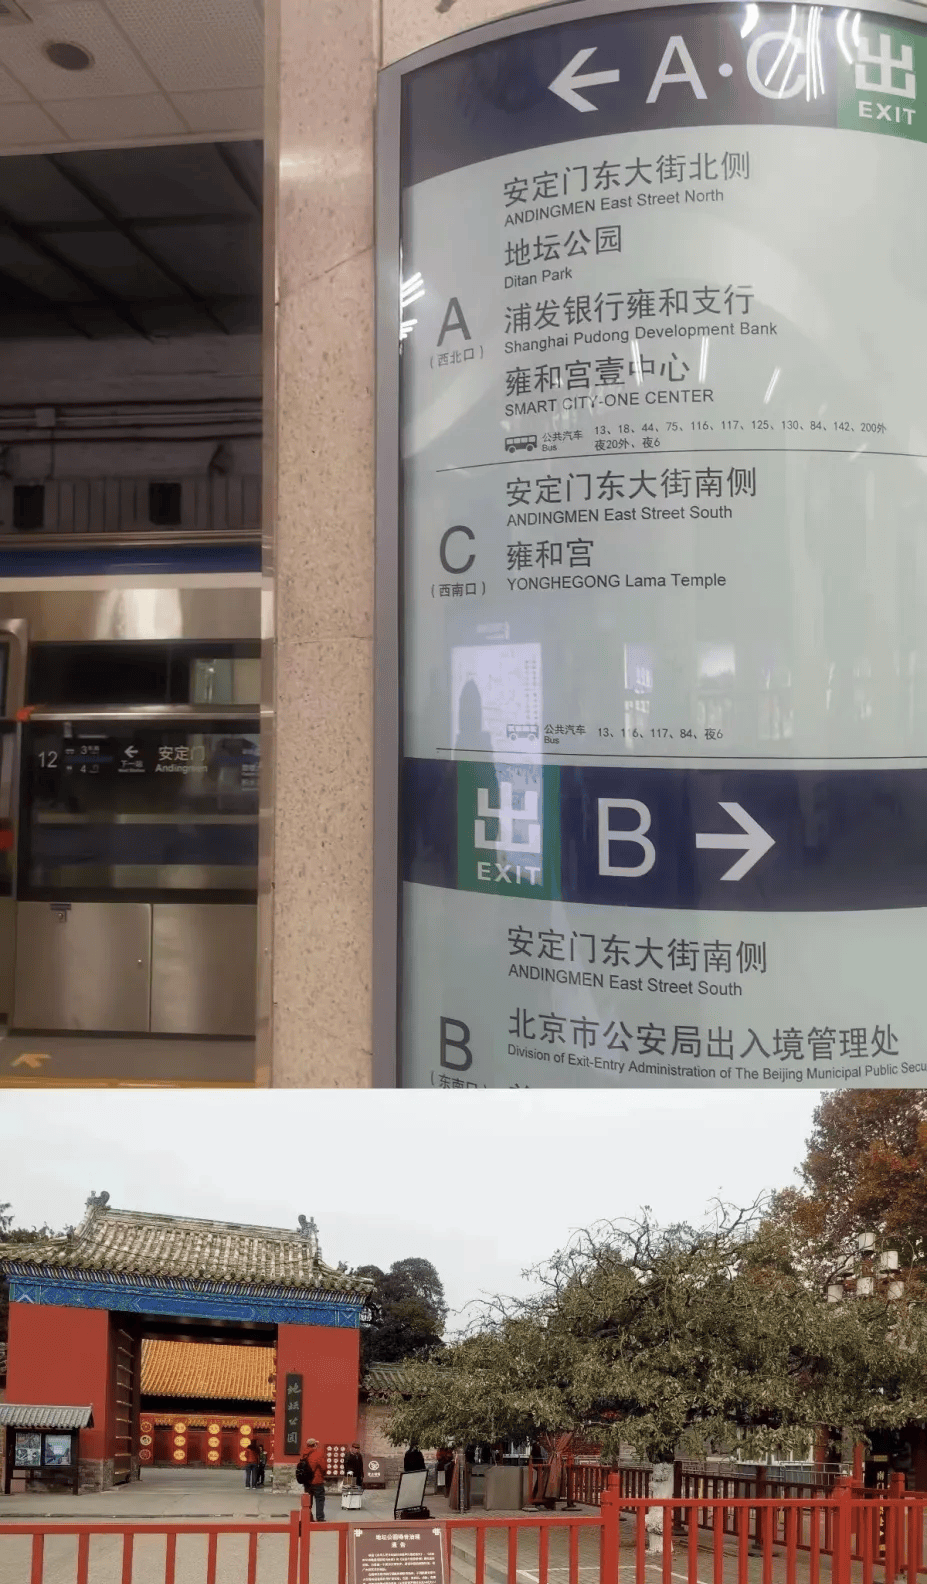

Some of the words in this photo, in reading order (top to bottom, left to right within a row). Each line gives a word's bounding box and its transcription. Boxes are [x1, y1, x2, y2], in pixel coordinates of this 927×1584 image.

[855, 33, 916, 100] 出
[858, 101, 916, 125] EXIT
[504, 151, 751, 207] 安定门东大街北侧
[504, 199, 595, 227] ANDINGMEN
[600, 195, 633, 212] East
[636, 190, 682, 207] Street
[685, 187, 724, 203] North
[504, 224, 622, 267] 地坛公园
[504, 272, 537, 289] Ditan
[542, 267, 573, 284] Park
[436, 297, 472, 346] A
[504, 283, 755, 335] 浦发银行雍和支行
[504, 334, 569, 355] Shanghai
[574, 328, 630, 349] Pudong
[635, 323, 735, 344] Development
[740, 321, 777, 336] Bank
[505, 351, 689, 397] 雍和宫壹中心
[505, 399, 557, 417] SMART
[562, 392, 640, 410] CITY-ONE
[645, 389, 714, 405] CENTER
[542, 430, 583, 443] 公共汽车
[542, 443, 557, 452] Bus
[594, 437, 661, 451] 夜20外、夜6
[506, 466, 757, 507] 安定门东大街南侧
[507, 509, 599, 527] ANDINGMEN
[604, 507, 637, 522] East
[641, 505, 686, 520] Street
[690, 505, 733, 519] South
[439, 525, 476, 574] C
[506, 538, 594, 571] 雍和宫
[507, 573, 621, 591] YONGHEGONG
[625, 573, 666, 588] Lama
[670, 572, 727, 591] Temple
[544, 724, 587, 736] 公共汽车
[544, 736, 560, 745] Bus
[38, 750, 58, 768] 12
[158, 746, 205, 761] 安定门
[474, 782, 541, 853] 出
[597, 797, 656, 878] B
[477, 861, 541, 886] EXIT
[508, 925, 767, 974] 安定门东大街南侧
[508, 963, 604, 988] ANDINGMEN
[609, 974, 643, 991] East
[647, 977, 693, 994] Street
[697, 980, 742, 996] South
[439, 1016, 473, 1072] B
[508, 1007, 900, 1062] 北京市公安局出入境管理处
[508, 1043, 550, 1062] Division
[554, 1052, 565, 1063] of
[568, 1054, 625, 1074] Exit-Entry
[628, 1061, 715, 1078] Administration
[719, 1067, 732, 1079] of
[735, 1067, 758, 1080] The
[763, 1067, 803, 1082] Beijing
[806, 1066, 861, 1081] Municipal
[865, 1063, 898, 1076] Public
